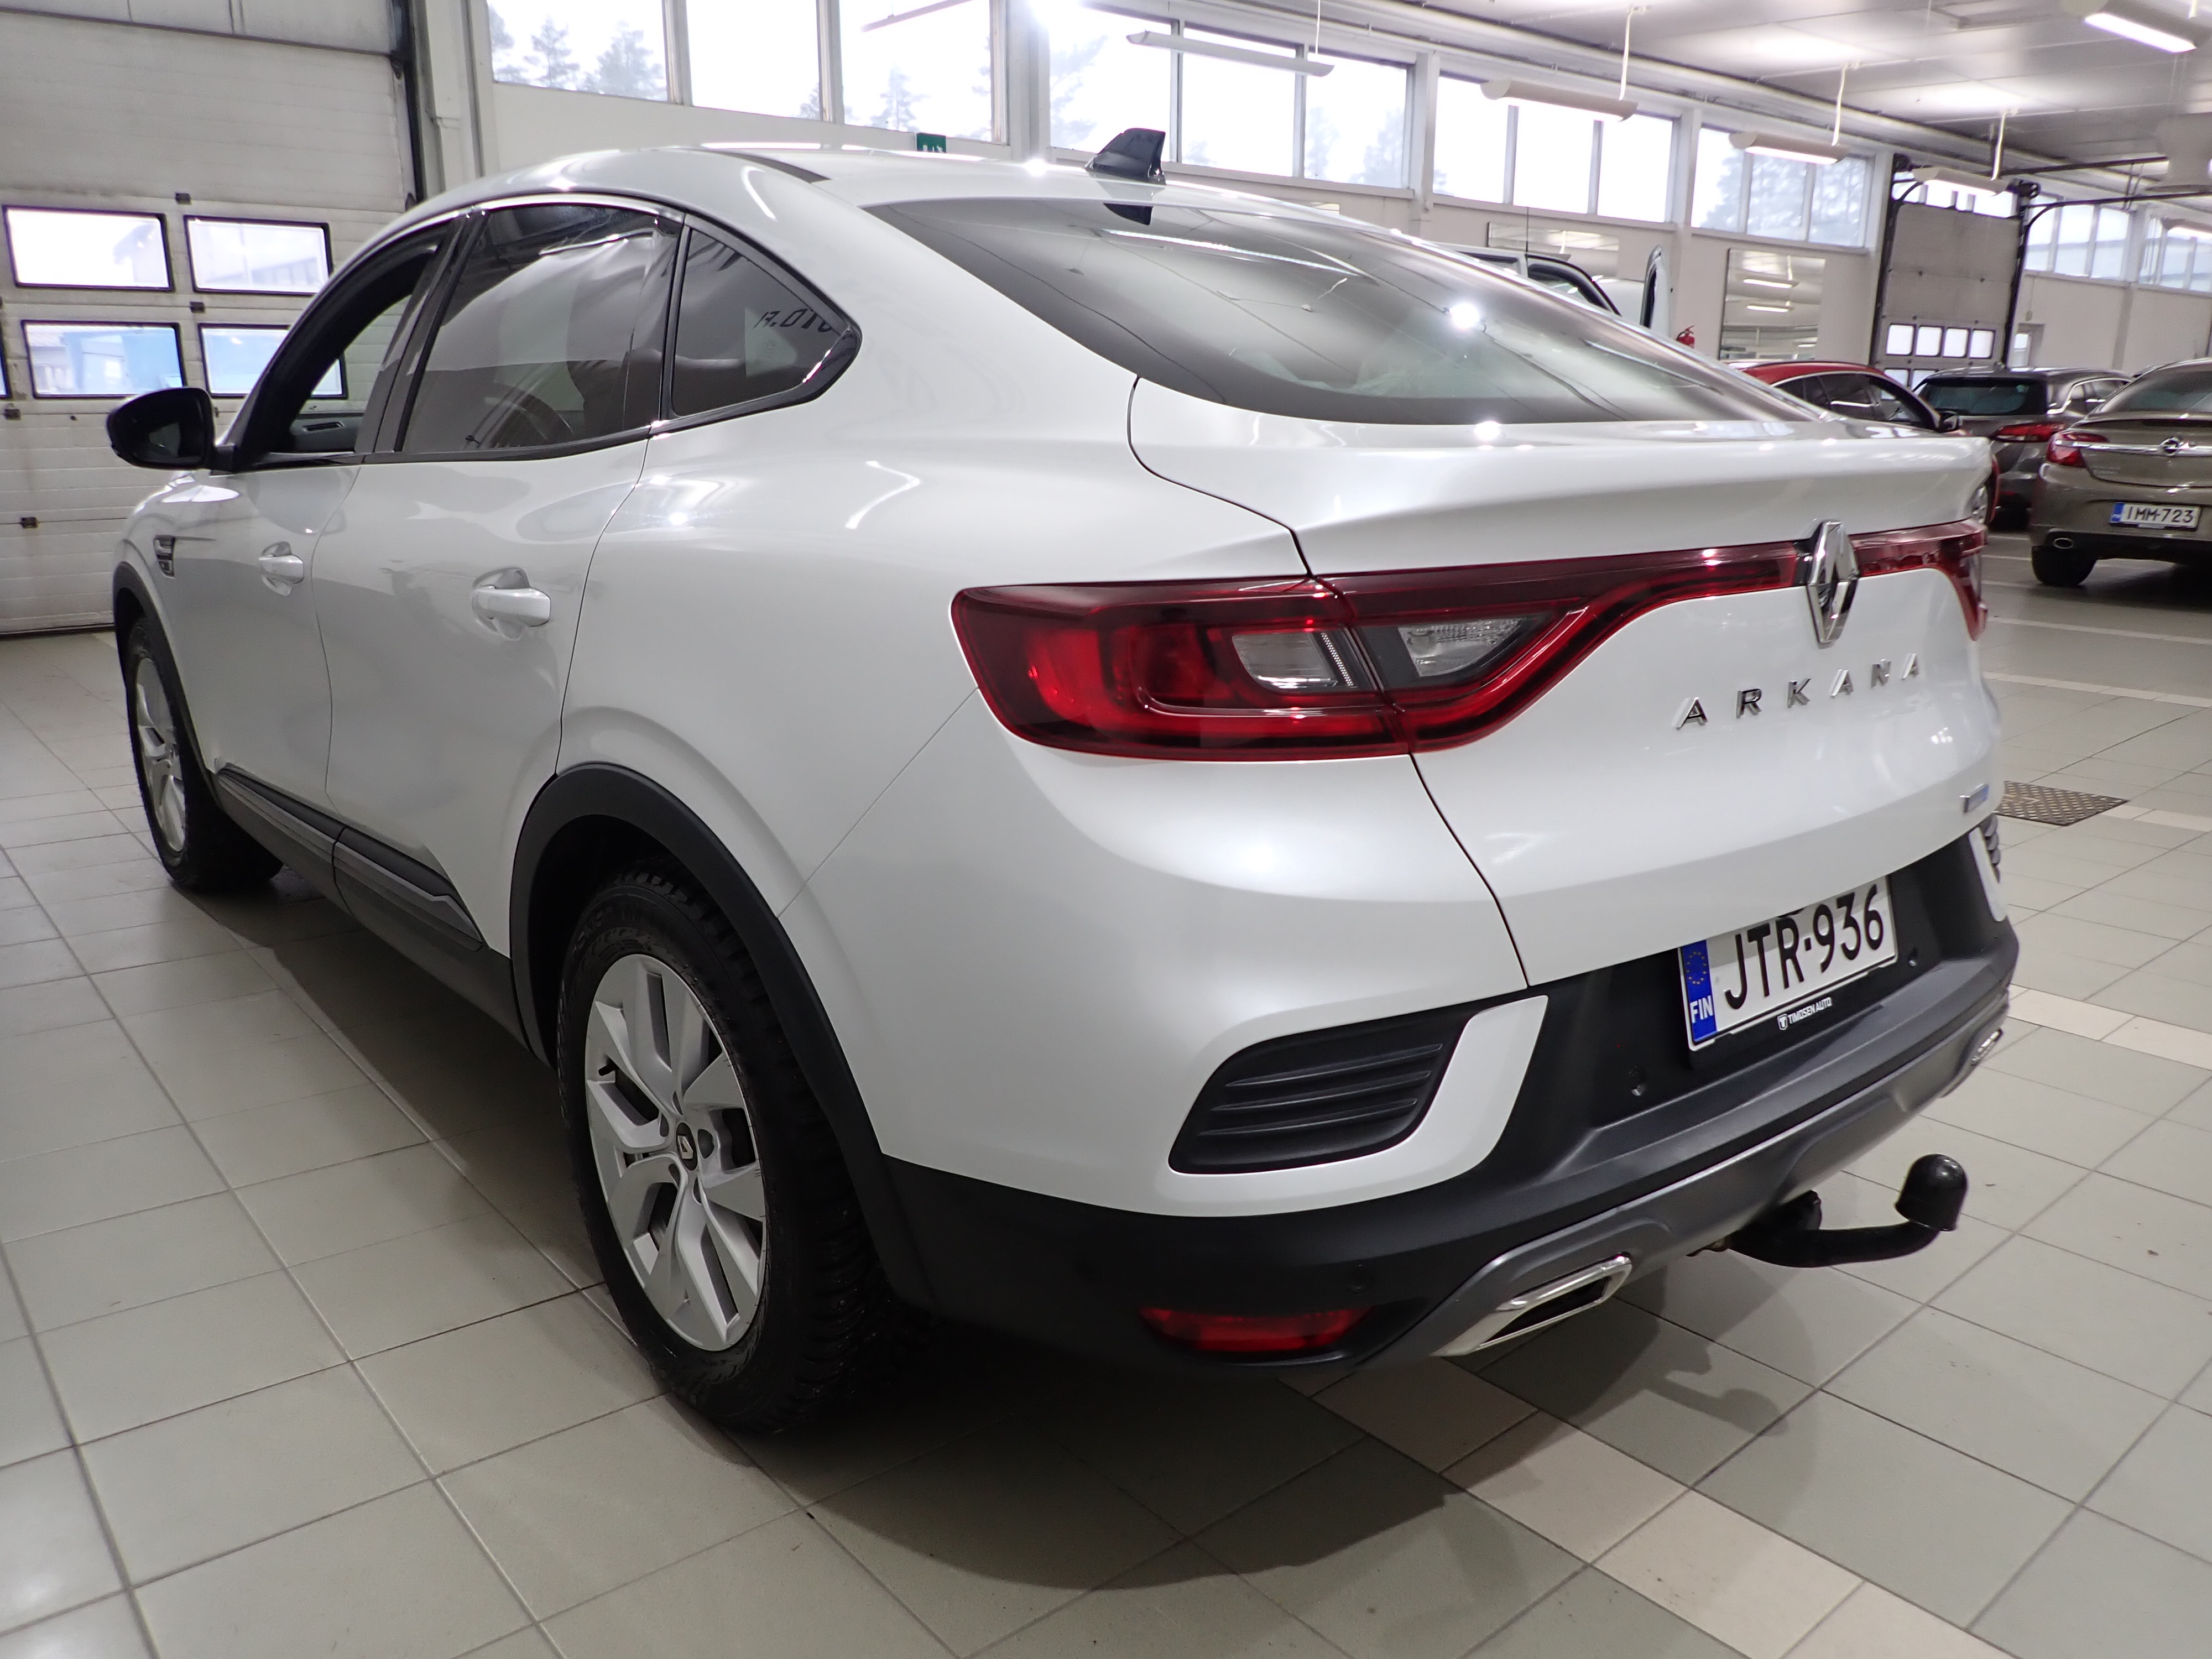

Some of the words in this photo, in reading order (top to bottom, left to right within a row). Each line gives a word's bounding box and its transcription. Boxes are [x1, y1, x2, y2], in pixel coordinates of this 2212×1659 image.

[2127, 506, 2194, 523] IMM-723
[1672, 653, 1919, 730] ARKANA
[1724, 883, 1884, 1010] JTR-936
[1690, 995, 1713, 1024] FIN
[1788, 1004, 1815, 1024] TIMOSEN
[1815, 997, 1832, 1012] AUTO
